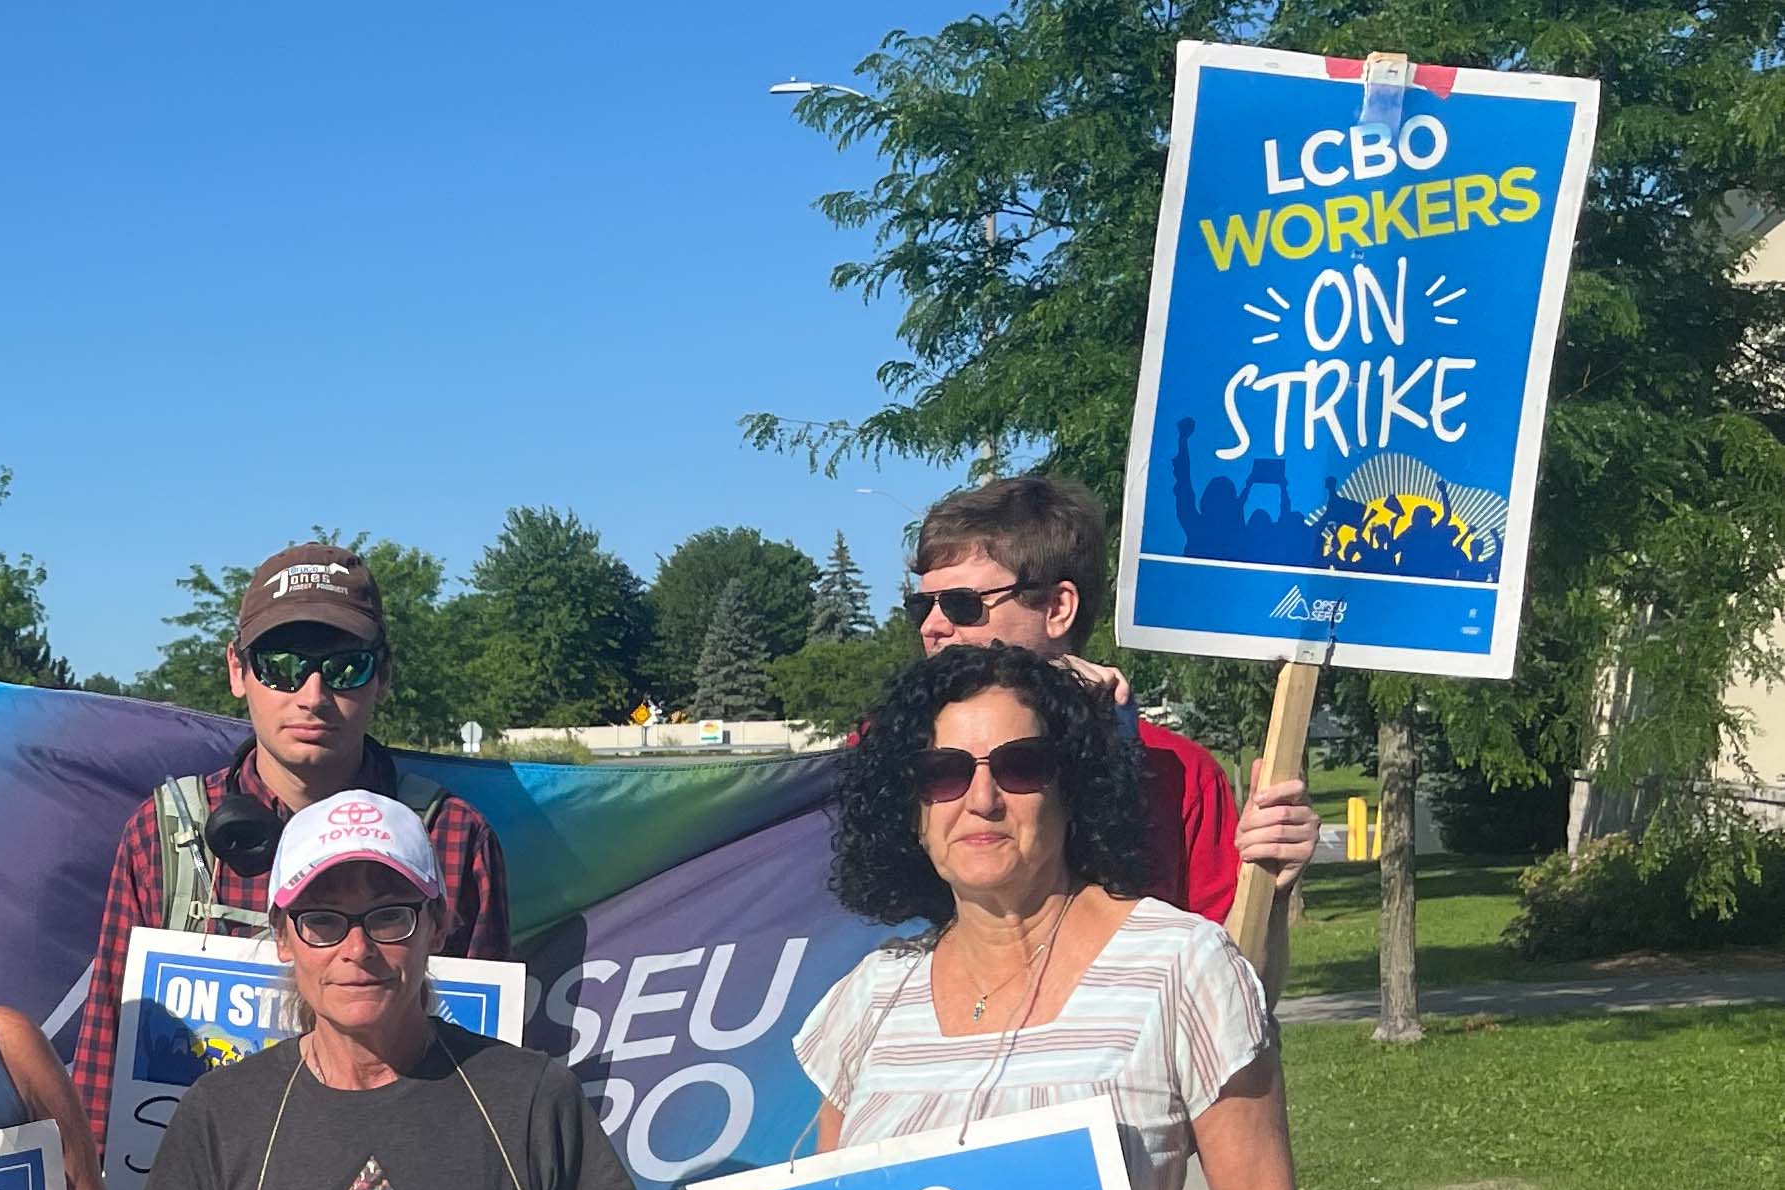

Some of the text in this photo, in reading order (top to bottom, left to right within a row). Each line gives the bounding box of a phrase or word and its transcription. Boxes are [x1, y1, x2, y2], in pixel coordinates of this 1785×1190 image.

[1264, 115, 1448, 195] LCBO
[1200, 167, 1541, 272] WORKERS
[1304, 257, 1407, 351] ON
[1215, 356, 1477, 460] STRIKE
[1313, 599, 1348, 612] OPSU
[318, 827, 391, 845] TOYOTA
[165, 976, 219, 1022] ON
[525, 937, 808, 1068] SEU
